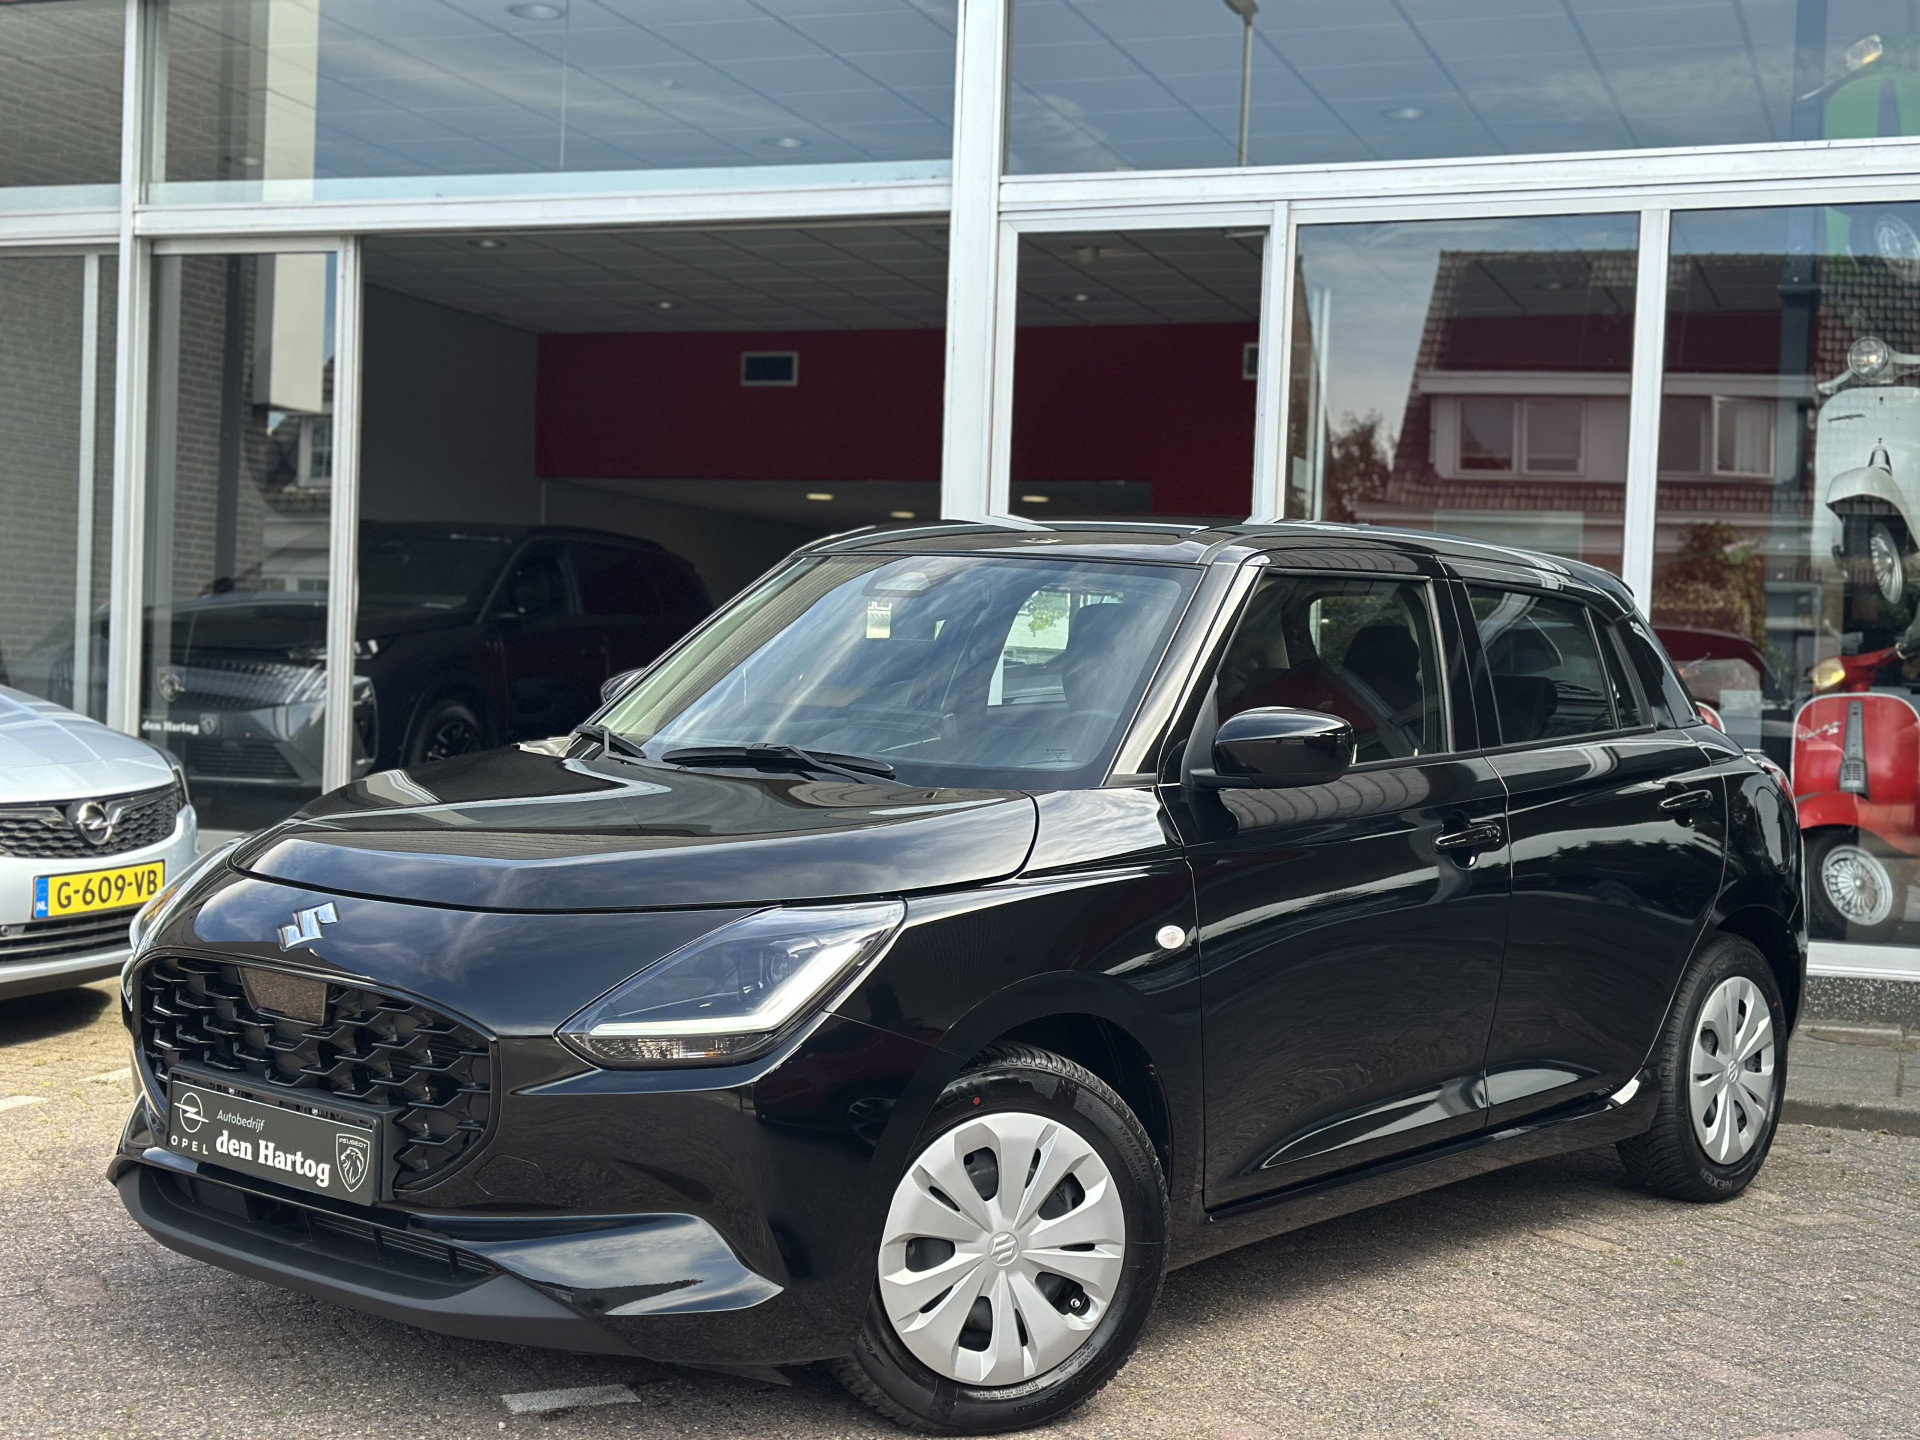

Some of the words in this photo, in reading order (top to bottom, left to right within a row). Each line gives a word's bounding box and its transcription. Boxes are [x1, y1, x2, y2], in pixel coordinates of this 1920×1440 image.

[163, 721, 199, 735] Hartog
[57, 869, 158, 909] G-609-VB
[36, 901, 48, 911] NL
[216, 1109, 265, 1133] Autobedrijf
[170, 1135, 209, 1155] OPEL
[338, 1137, 367, 1149] PEUGEOT
[215, 1129, 253, 1161] den
[257, 1139, 331, 1188] Hartog
[1700, 1167, 1732, 1190] NEXEN
